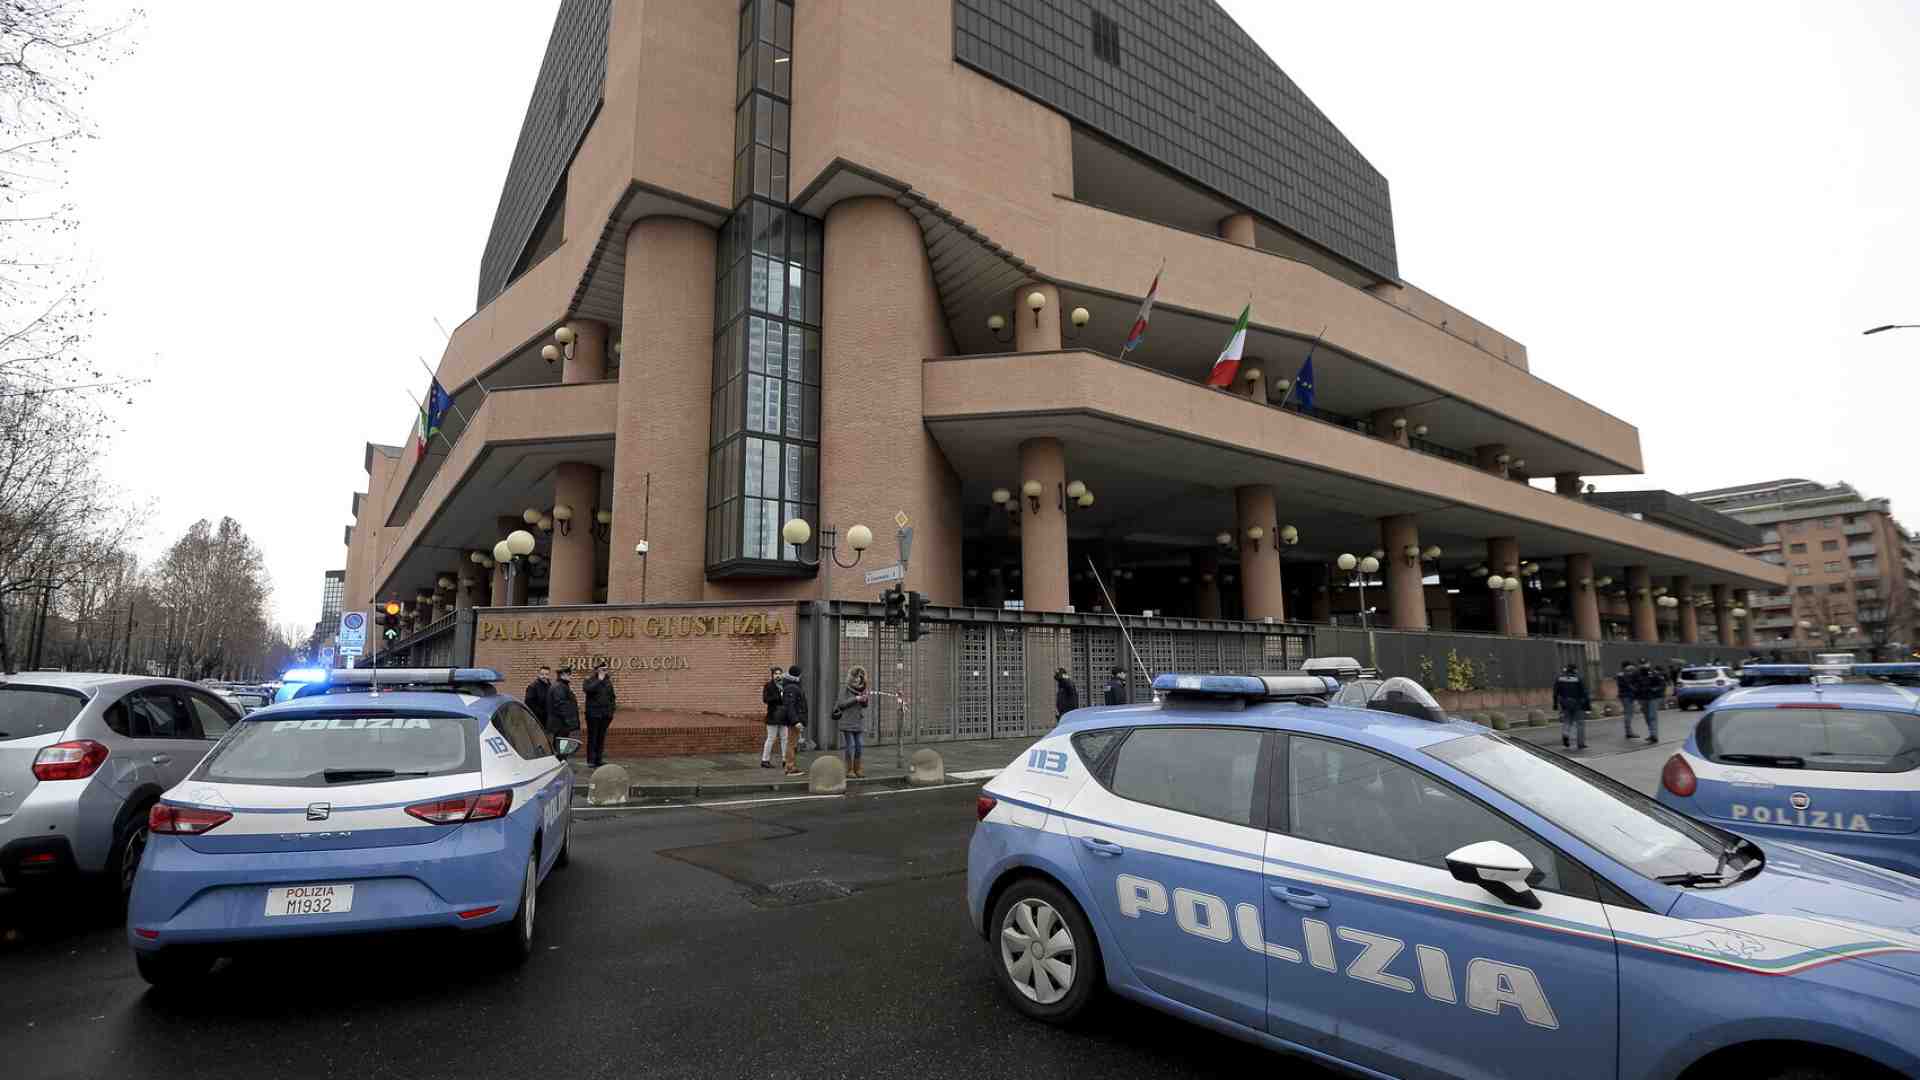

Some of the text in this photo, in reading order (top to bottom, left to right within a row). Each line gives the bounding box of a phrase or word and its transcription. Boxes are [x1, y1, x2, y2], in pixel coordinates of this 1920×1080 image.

[480, 612, 789, 642] PALAZZO DI GIUSTIZIA
[629, 655, 689, 671] CACCIA
[271, 718, 432, 734] POLIZIA
[1028, 749, 1068, 773] 113
[1731, 803, 1873, 832] POLIZIA
[286, 886, 335, 898] POLIZIA
[286, 898, 332, 914] M1932
[1115, 873, 1560, 1030] POLIZIA
